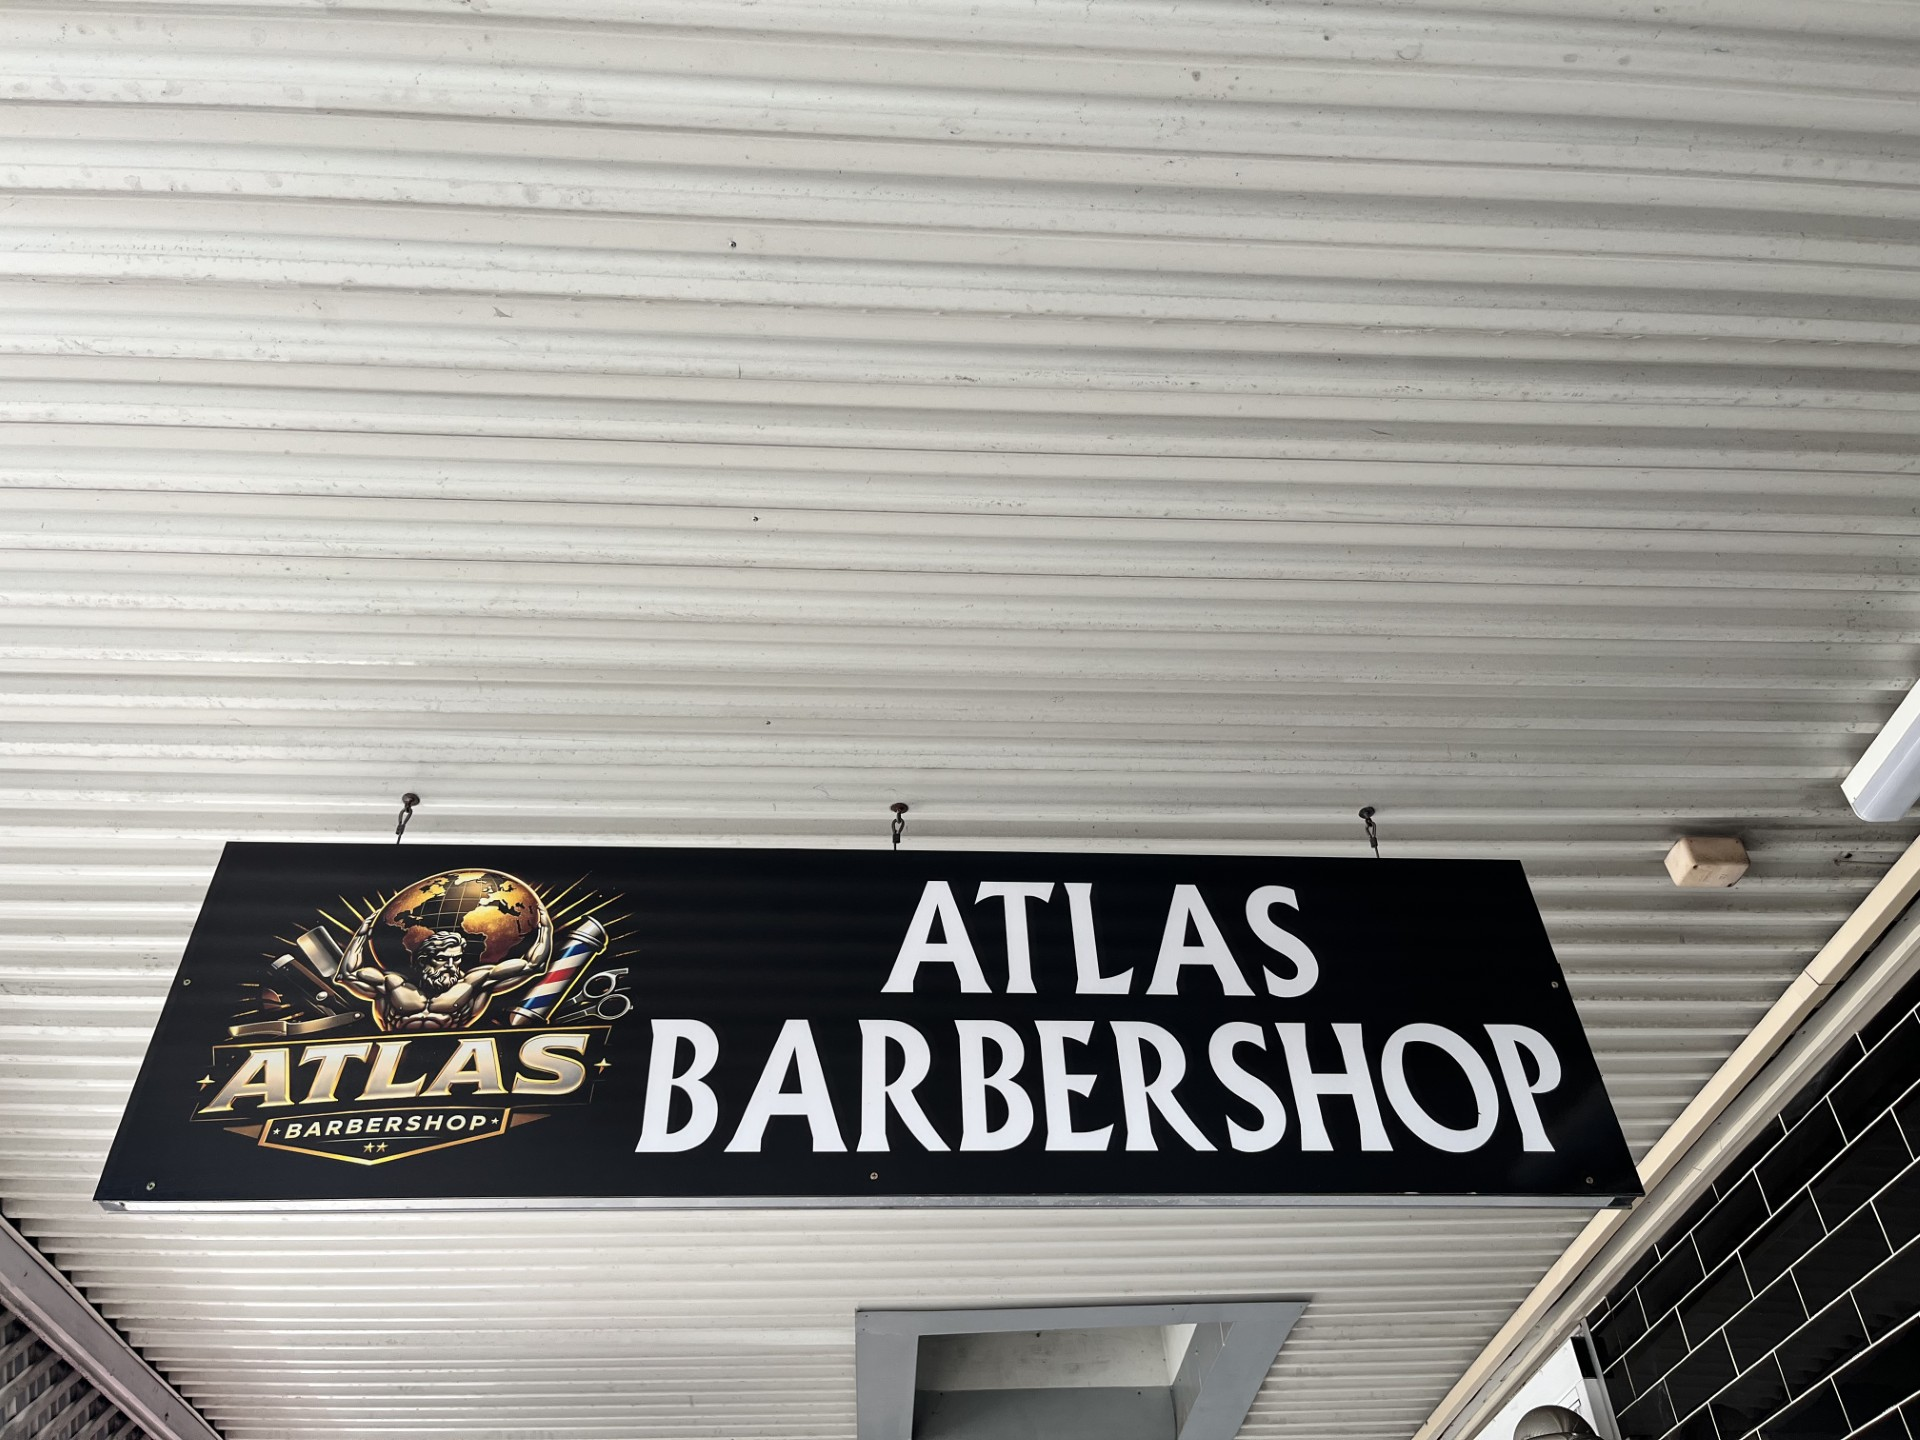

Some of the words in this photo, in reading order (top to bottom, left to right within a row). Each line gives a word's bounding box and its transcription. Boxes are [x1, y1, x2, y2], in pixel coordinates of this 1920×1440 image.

[881, 880, 1319, 998] ATLAS
[197, 1033, 590, 1114] ATLAS
[634, 1018, 1562, 1154] BARBERSHOP
[284, 1114, 487, 1139] BARBERSHOP
